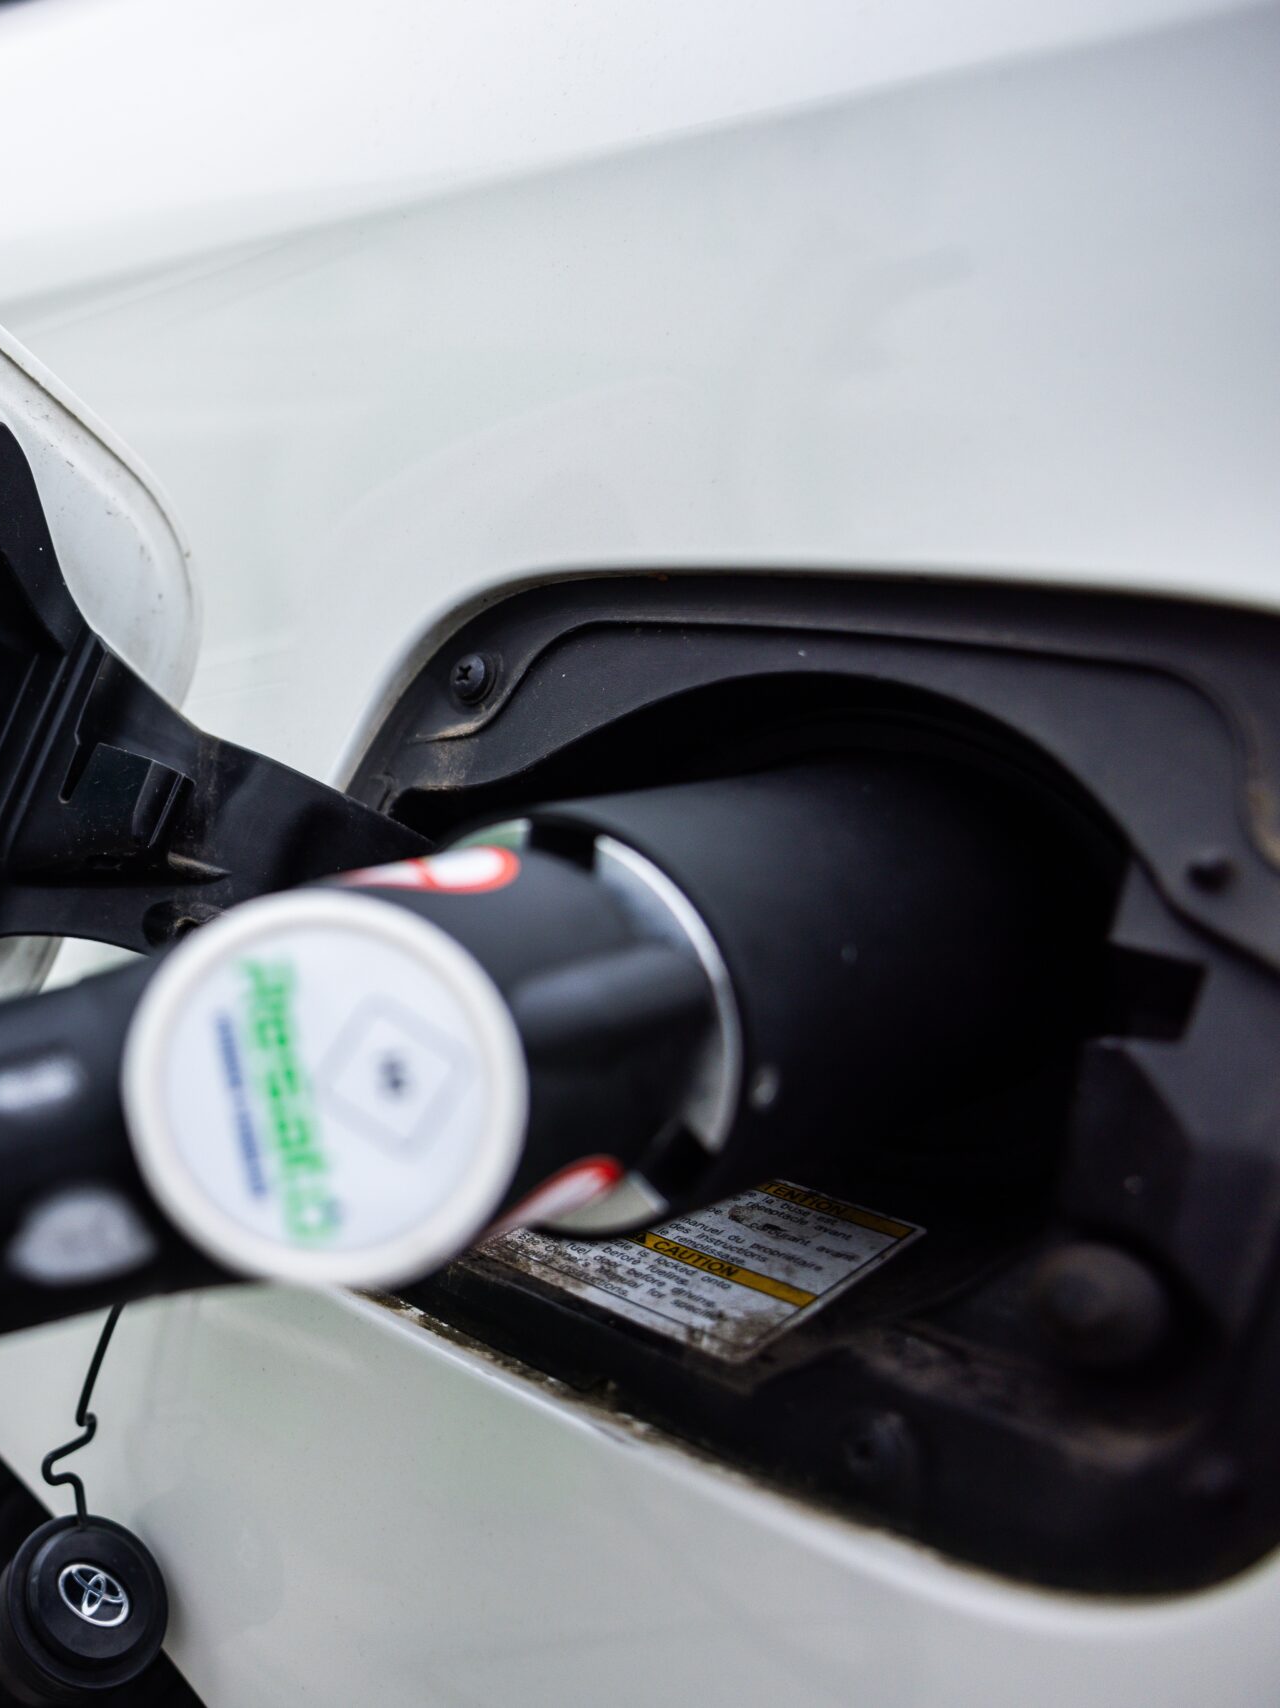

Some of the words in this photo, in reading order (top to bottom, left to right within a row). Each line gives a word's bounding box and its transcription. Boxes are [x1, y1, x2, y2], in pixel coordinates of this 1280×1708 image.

[764, 1184, 849, 1215] TENTION
[780, 1202, 811, 1217] buse
[657, 1227, 669, 1235] le
[669, 1222, 691, 1234] des
[696, 1232, 768, 1263] instructions
[679, 1216, 724, 1235] manuel
[728, 1234, 746, 1244] du
[567, 1241, 592, 1255] fuel
[593, 1255, 621, 1268] door
[626, 1268, 666, 1287] before
[602, 1246, 641, 1265] before
[637, 1250, 650, 1258] is
[654, 1256, 698, 1276] locked
[701, 1276, 731, 1290] onto
[653, 1240, 739, 1276] CAUTION
[647, 1288, 666, 1298] for
